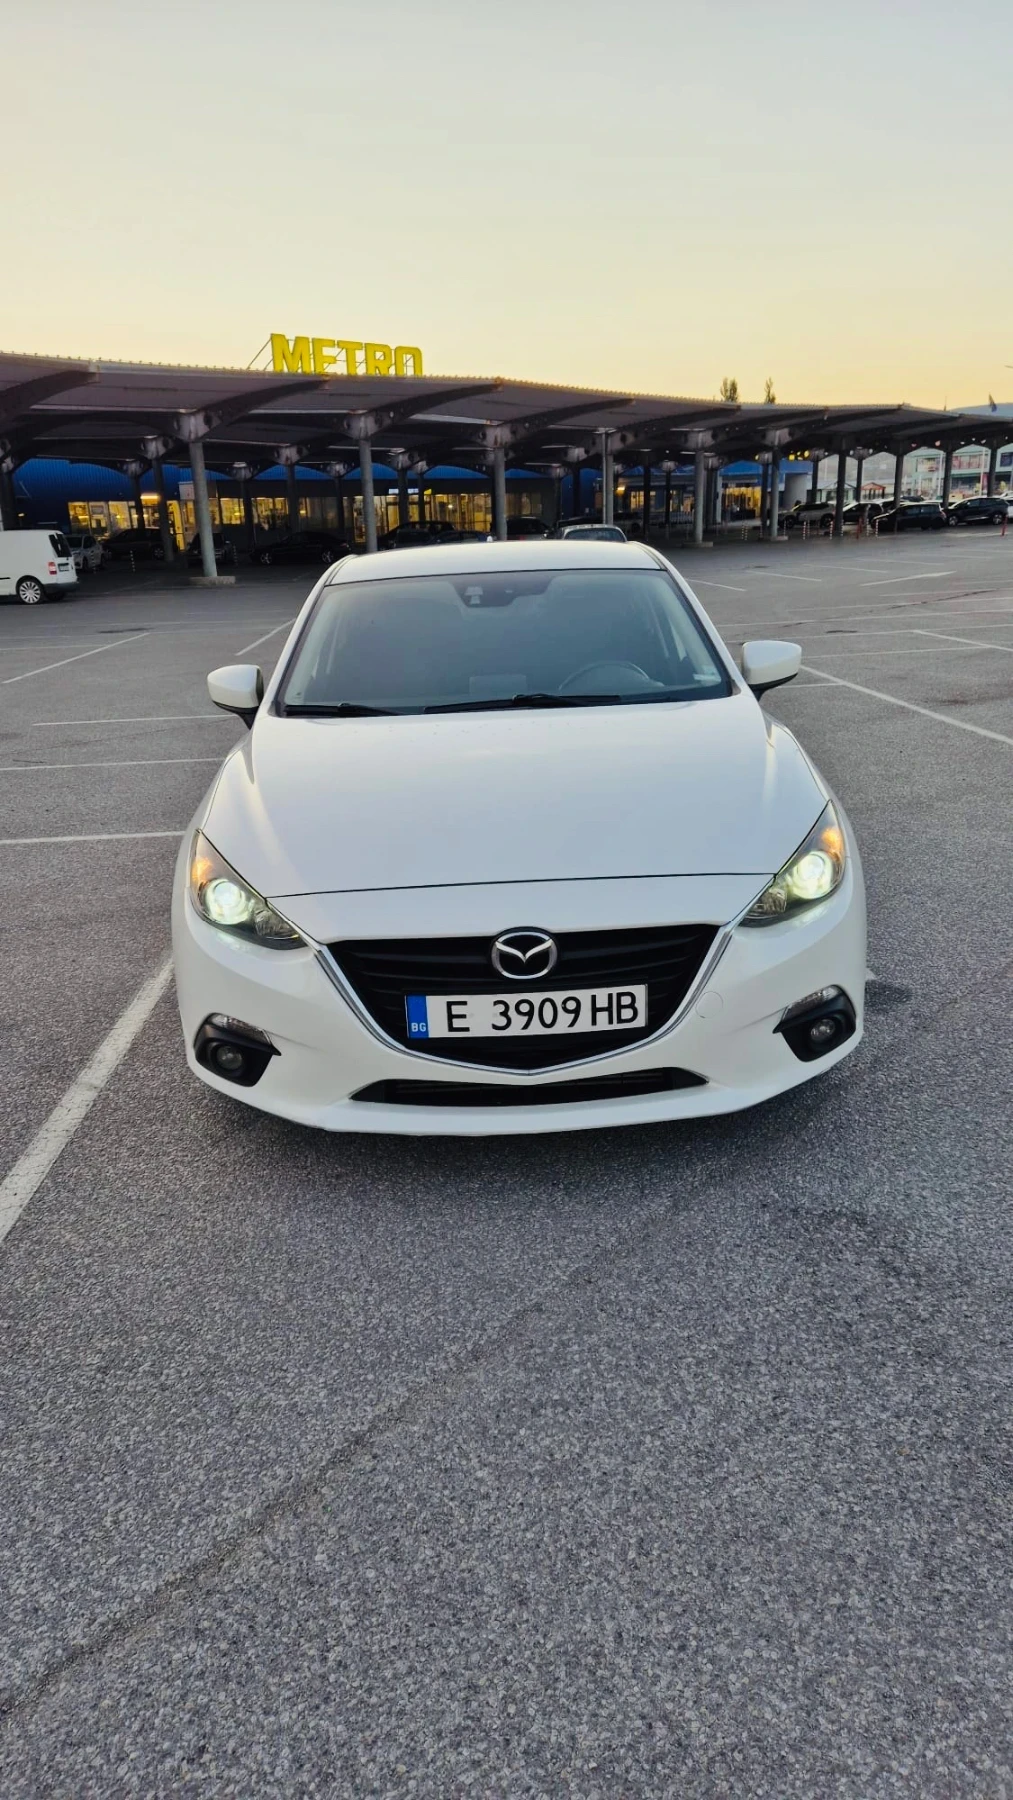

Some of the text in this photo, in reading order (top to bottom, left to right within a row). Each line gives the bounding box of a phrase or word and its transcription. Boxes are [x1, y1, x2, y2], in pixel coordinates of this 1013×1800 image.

[270, 333, 423, 376] METRO
[411, 1022, 427, 1032] BG
[446, 991, 639, 1032] E 3909 HB
